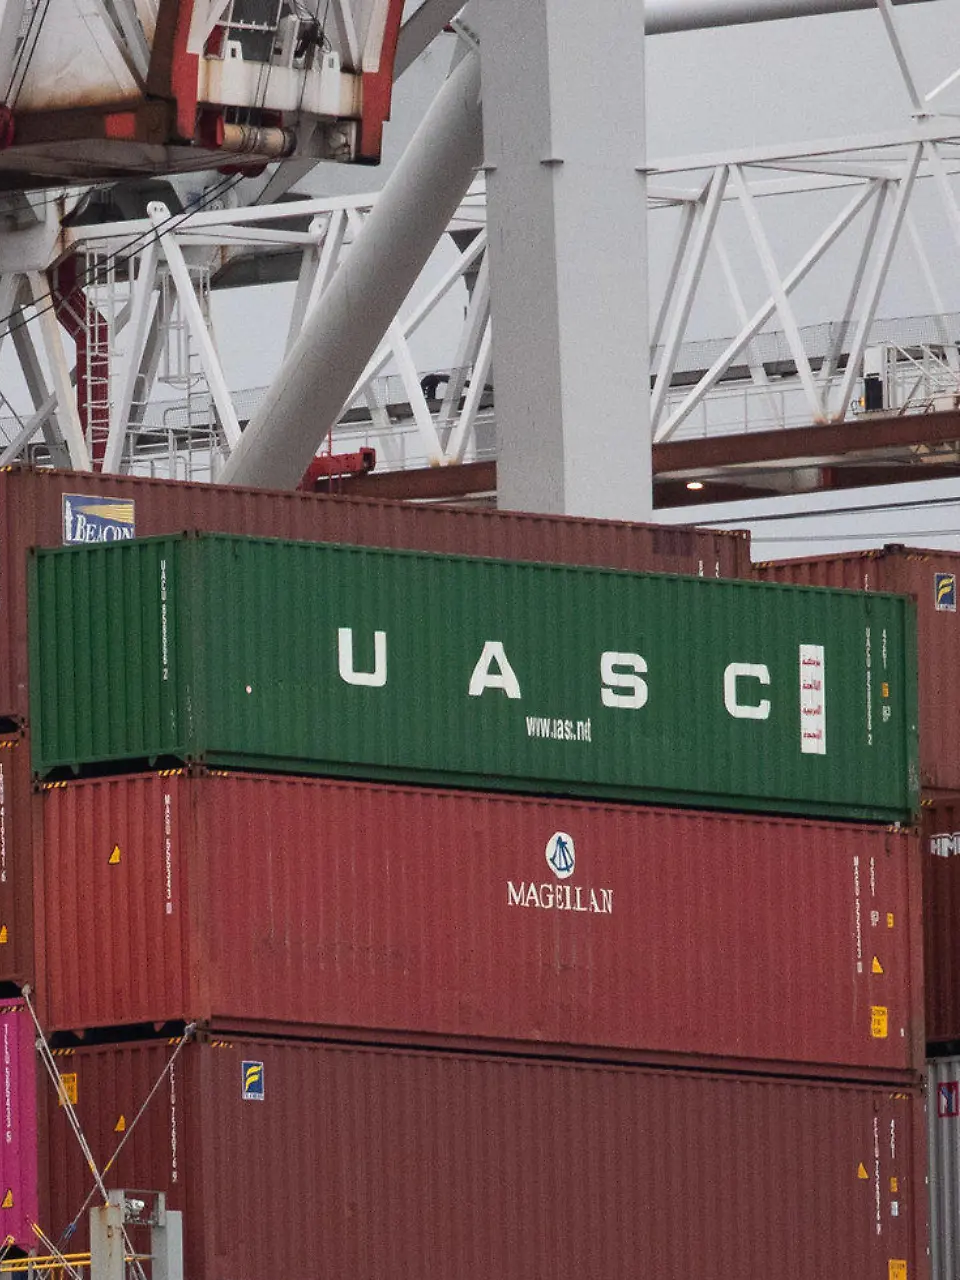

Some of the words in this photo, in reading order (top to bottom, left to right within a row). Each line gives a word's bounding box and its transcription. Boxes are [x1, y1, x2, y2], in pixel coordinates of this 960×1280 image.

[72, 514, 135, 543] BEACON
[930, 834, 960, 858] HM
[507, 881, 613, 914] MAGELLAN
